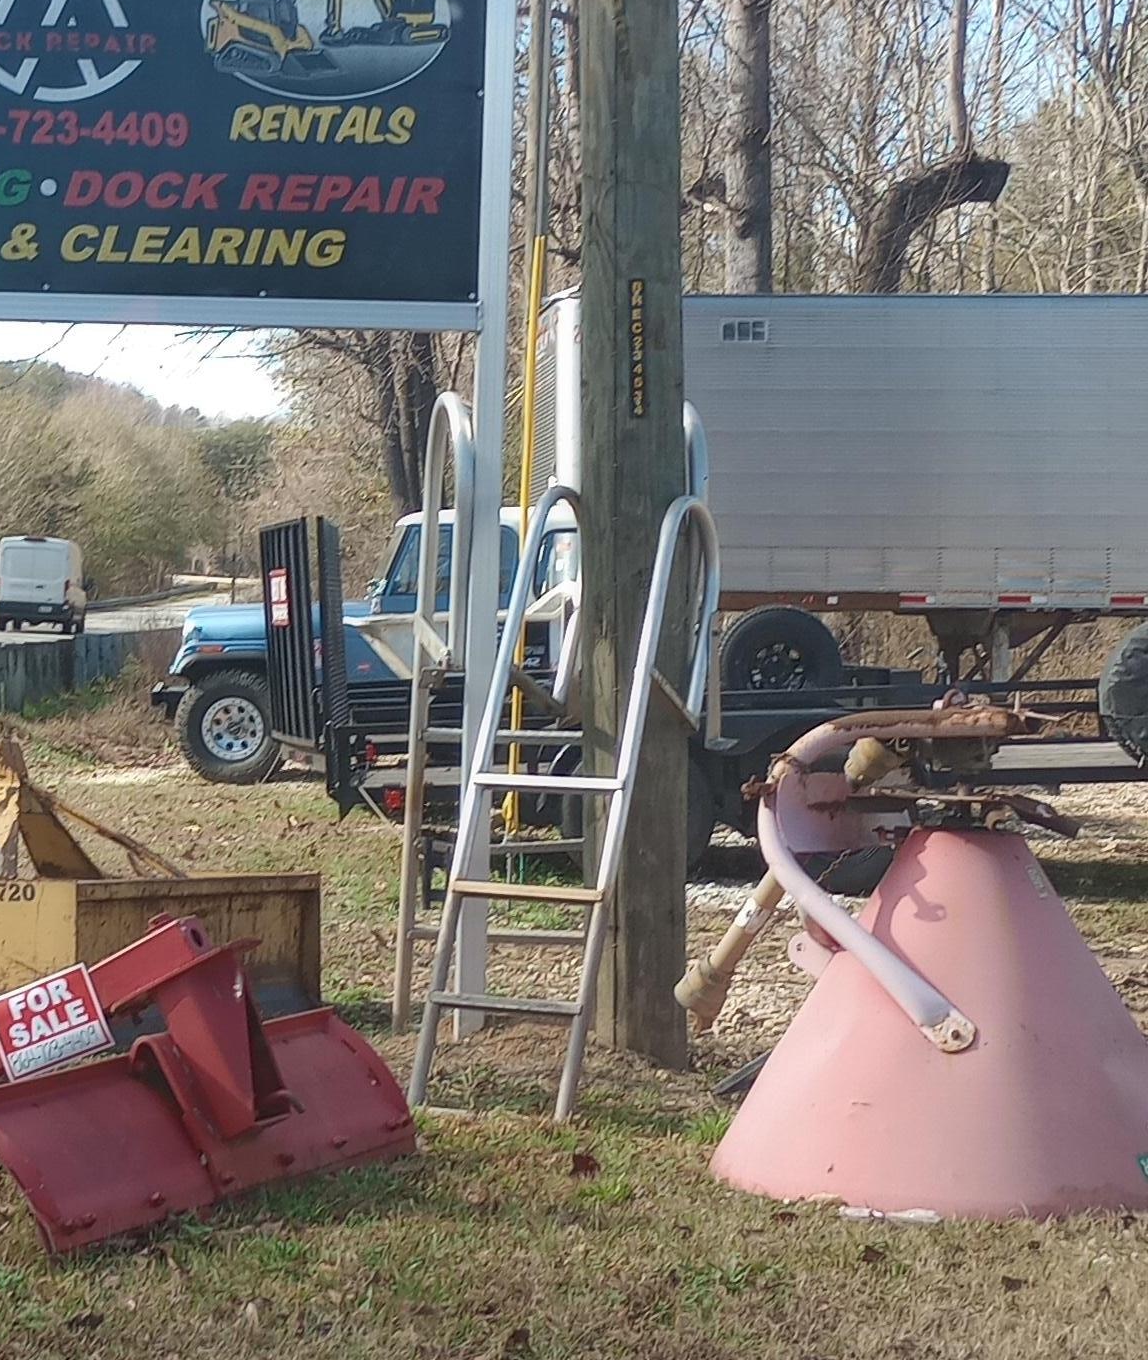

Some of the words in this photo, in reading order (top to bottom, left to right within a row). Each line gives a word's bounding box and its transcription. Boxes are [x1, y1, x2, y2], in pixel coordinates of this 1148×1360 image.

[46, 32, 157, 53] REPAIR
[229, 104, 416, 144] RENTALS
[64, 171, 227, 210] DOCK
[239, 175, 446, 215] REPAIR
[0, 223, 40, 261] &
[60, 224, 347, 267] CLEARING
[8, 978, 74, 1021] FOR
[9, 998, 89, 1048] SALE
